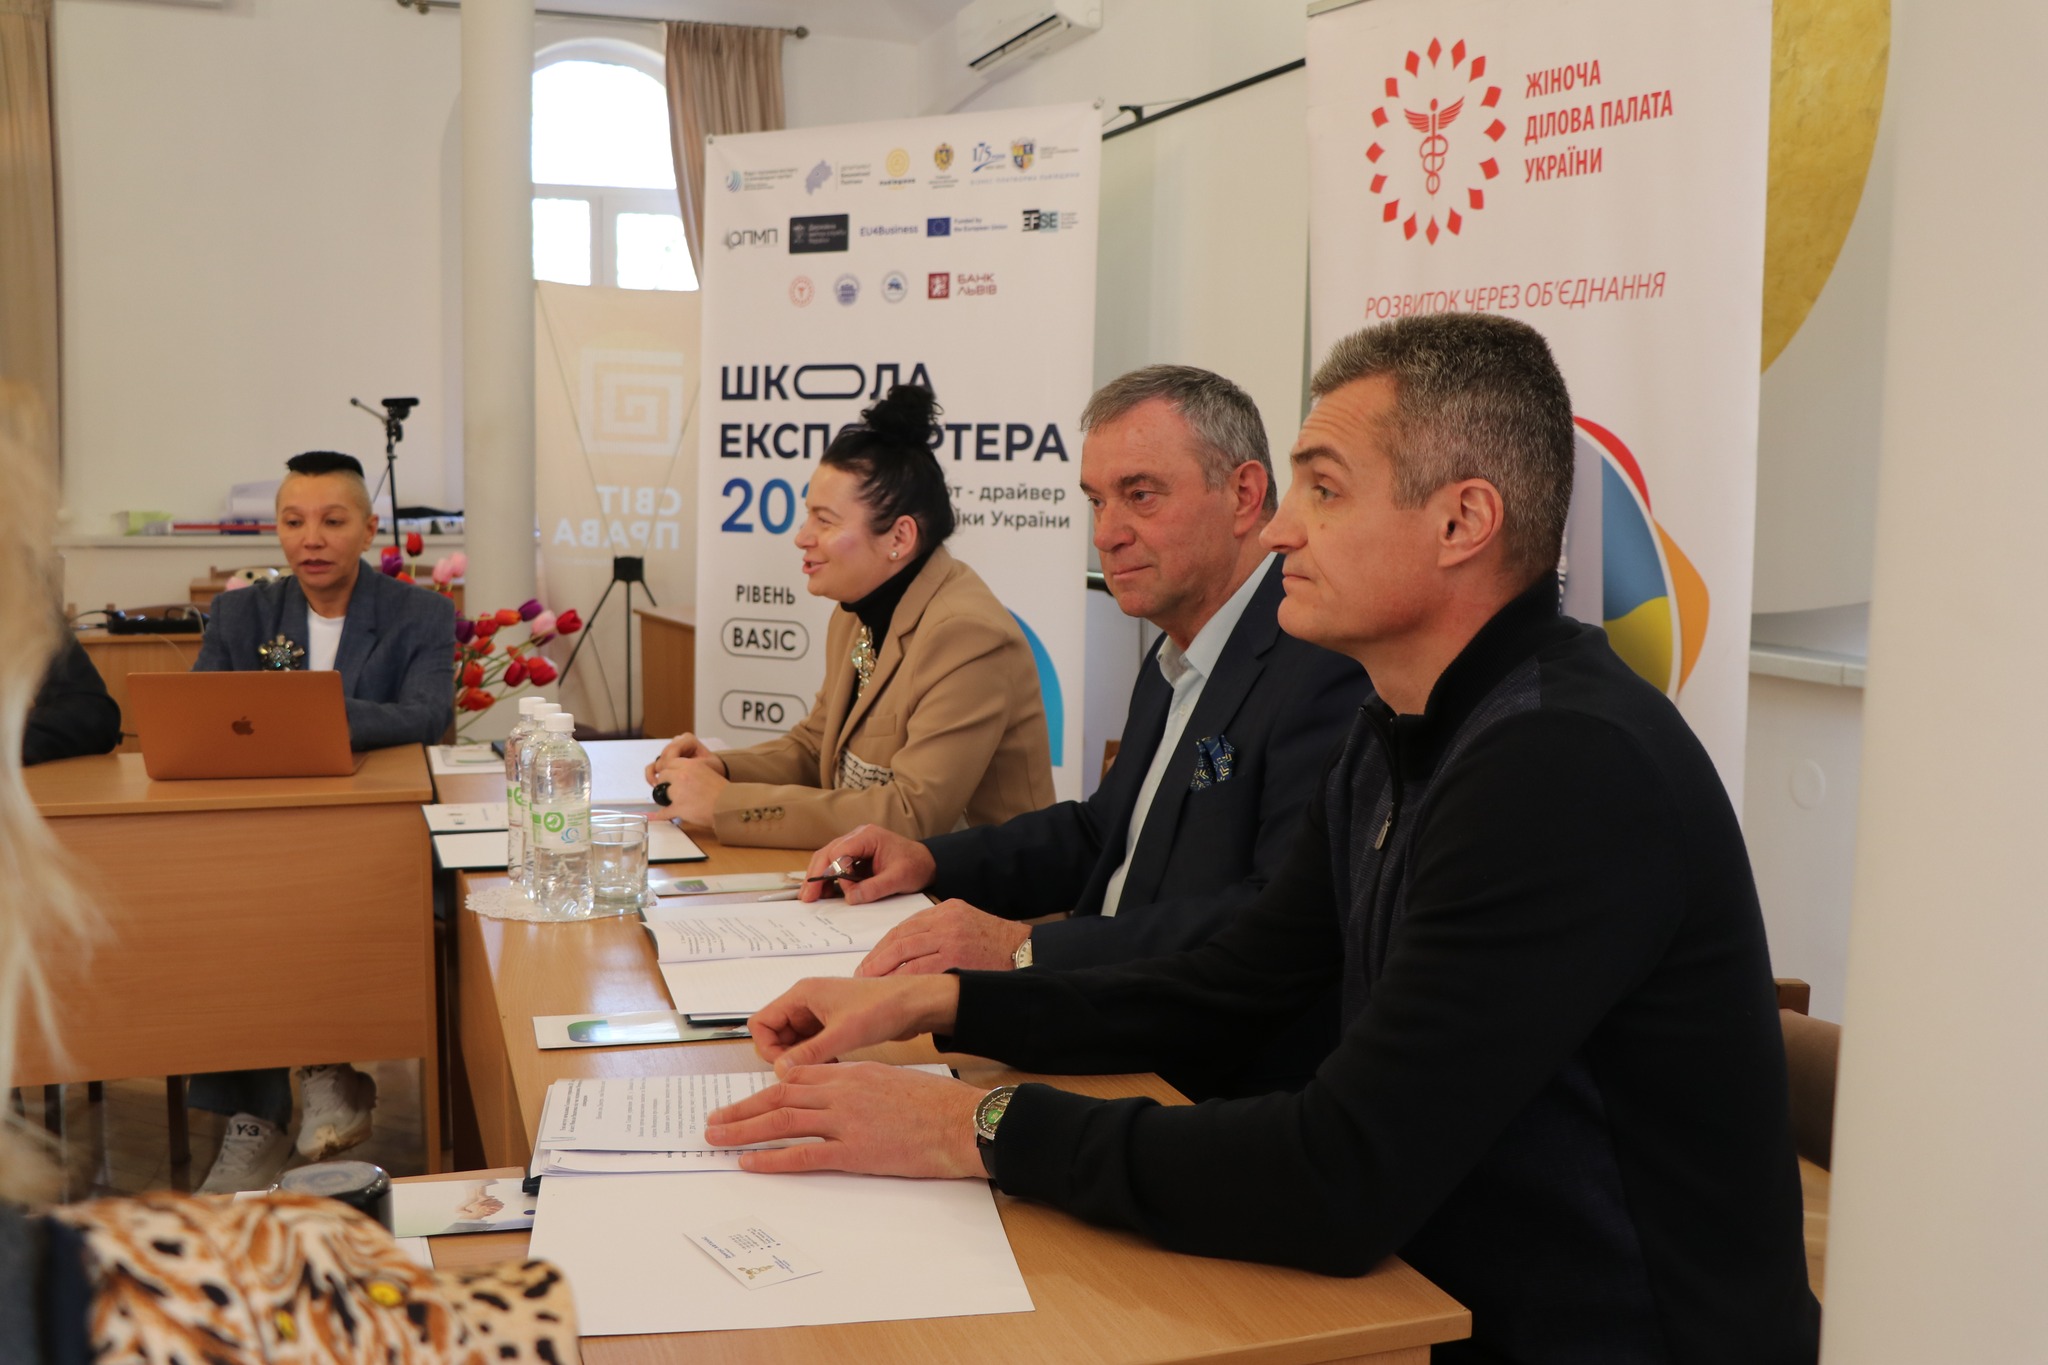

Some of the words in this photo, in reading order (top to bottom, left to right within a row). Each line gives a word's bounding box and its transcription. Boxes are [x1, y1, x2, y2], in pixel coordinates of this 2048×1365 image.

[1525, 59, 1602, 99] ЖІНОЧА
[1524, 104, 1595, 146] ДІЛОВА
[1600, 90, 1674, 128] ПАЛАТА
[1524, 146, 1604, 184] УКРАЇНИ
[860, 225, 919, 237] EU4Business
[957, 273, 995, 284] БАНК
[957, 284, 998, 296] ЛЬВІВ
[1365, 289, 1461, 319] РОЗВИТОК
[1464, 285, 1521, 312] ЧЕРЕЗ
[979, 483, 1066, 506] драйвер
[991, 509, 1071, 532] України
[736, 584, 797, 606] РІВЕНЬ
[732, 627, 797, 653] BASIC
[741, 701, 785, 724] PRO
